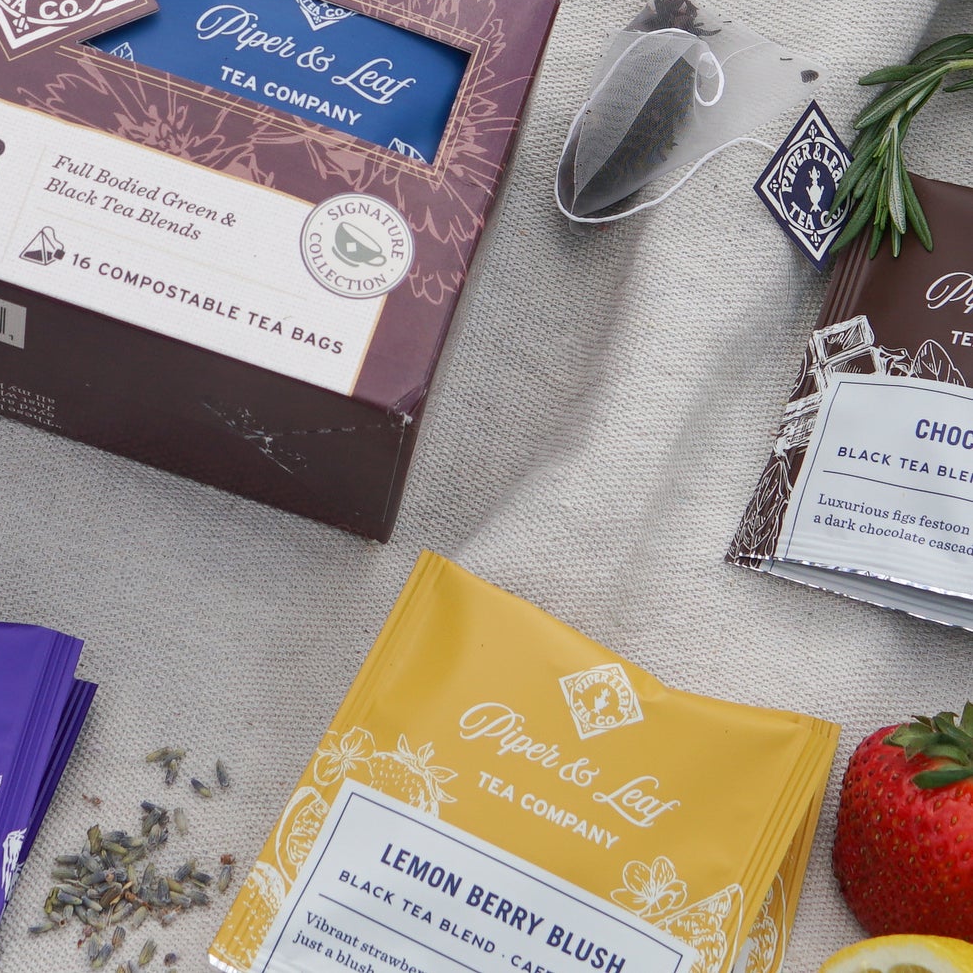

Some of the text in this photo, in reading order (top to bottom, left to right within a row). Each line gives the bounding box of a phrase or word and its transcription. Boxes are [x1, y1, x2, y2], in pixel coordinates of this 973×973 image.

[195, 3, 418, 106] Piper & Leaf
[221, 65, 363, 126] TEA COMPANY
[43, 176, 202, 241] Black Tea Blends
[51, 154, 237, 228] Full Bodied Green &
[309, 232, 388, 291] COLLECTION
[327, 202, 405, 260] SIGNATURE
[72, 253, 344, 355] 16 COMPOSTABLE TEA BAGS
[837, 446, 930, 474] BLACK TEA
[817, 493, 970, 536] Luxurious figs festoon
[458, 700, 682, 828] Piper & Leaf
[478, 770, 620, 850] TEA COMPANY
[338, 869, 496, 954] BLACK TEA BLEND
[380, 843, 626, 973] LEMON BERRY BLUSH
